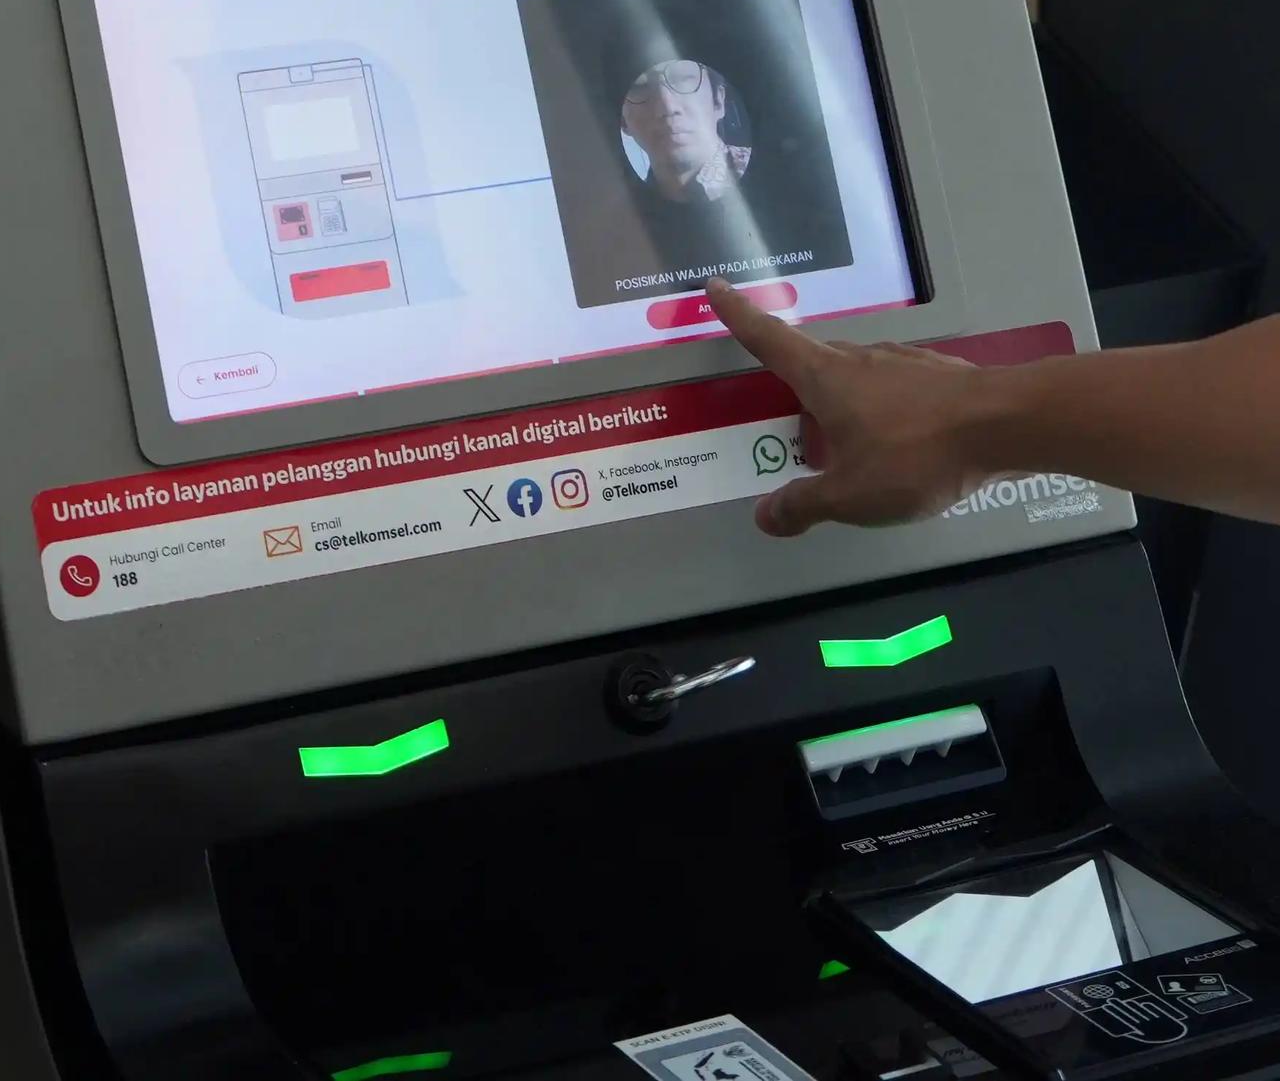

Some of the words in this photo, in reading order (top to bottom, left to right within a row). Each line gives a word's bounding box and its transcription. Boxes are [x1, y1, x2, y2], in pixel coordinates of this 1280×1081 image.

[615, 273, 674, 291] POSISIKAN
[675, 266, 718, 282] WAJAH
[719, 260, 750, 275] PADA
[752, 250, 813, 269] LINGKARAN
[214, 365, 259, 381] Kembali
[52, 494, 123, 522] Untuk
[125, 487, 170, 510] info
[173, 472, 259, 505] layanan
[263, 455, 372, 491] pelanggan
[374, 439, 461, 470] hubungi
[463, 424, 519, 453] kanal
[523, 415, 585, 445] digital
[588, 403, 668, 433] berikut:
[610, 459, 663, 478] Facebook,
[664, 450, 719, 469] Instagram
[601, 476, 678, 502] @Telkomsel
[310, 517, 342, 532] Email
[314, 519, 442, 553] cs@telkomsel.com
[109, 547, 160, 566] Hubungi
[161, 542, 185, 558] Call
[187, 536, 226, 554] Center
[112, 571, 138, 588] 188
[629, 1035, 661, 1048] SCAN
